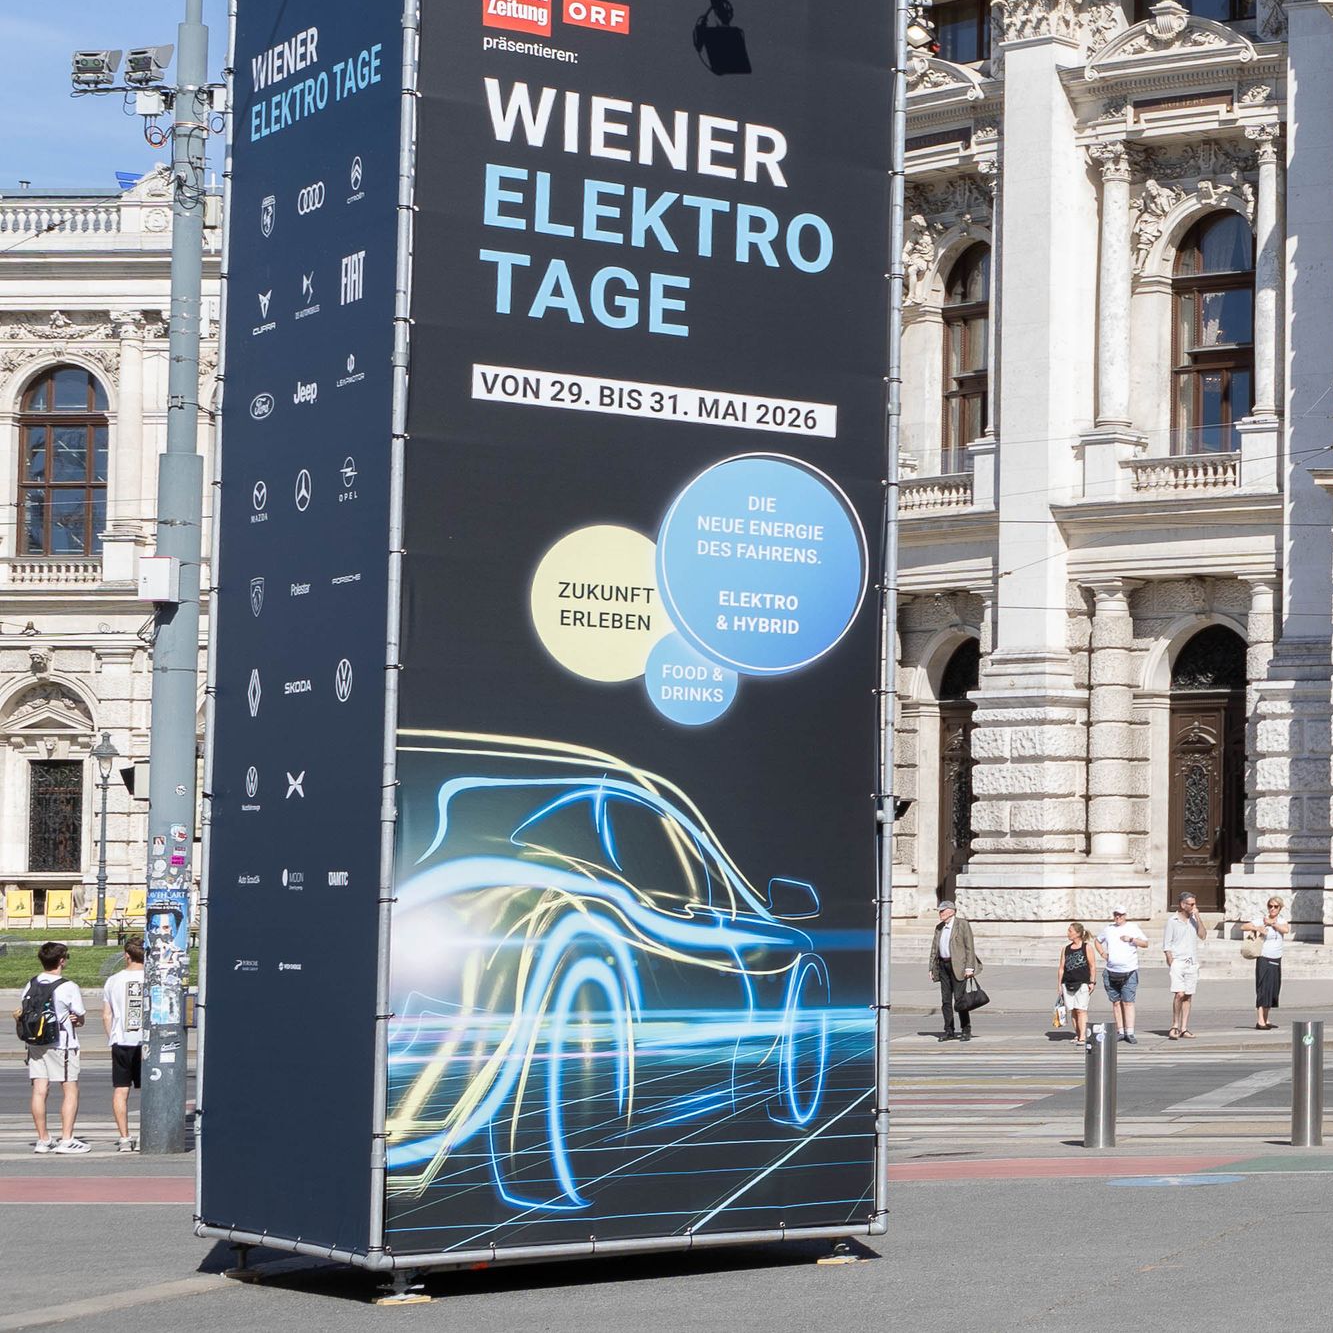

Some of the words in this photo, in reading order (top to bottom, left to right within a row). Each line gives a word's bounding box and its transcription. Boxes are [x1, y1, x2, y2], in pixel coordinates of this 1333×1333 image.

[568, 2, 625, 27] ORF
[252, 26, 319, 93] WIENER
[483, 37, 578, 64] präsentieren:
[251, 71, 329, 142] ELEKTRO
[333, 43, 382, 101] TAGE
[483, 77, 788, 188] WIENER
[483, 163, 834, 274] ELEKTRO
[340, 250, 366, 306] FIAT
[479, 248, 690, 337] TAGE
[252, 322, 277, 336] CUPRA
[293, 381, 318, 405] Jeep
[480, 371, 541, 399] VON
[549, 379, 591, 406] 29.
[599, 385, 642, 410] BIS
[649, 391, 689, 417] 31.
[697, 396, 747, 423] MAI
[755, 403, 817, 430] 2026
[254, 397, 270, 416] Ford
[338, 491, 359, 503] OPEL
[748, 496, 776, 513] DIE
[251, 512, 269, 524] MAZDA
[697, 516, 744, 535] NEUE
[749, 521, 824, 542] ENERGIE
[697, 540, 730, 557] DES
[736, 543, 822, 565] FAHRENS.
[290, 582, 312, 597] Polestar
[331, 573, 361, 585] PORSCHE
[558, 581, 655, 605] ZUKUNFT
[718, 591, 798, 611] ELEKTRO
[560, 610, 652, 632] ERLEBEN
[716, 615, 728, 632] &
[733, 616, 800, 635] HYBRID
[661, 664, 708, 681] FOOD
[712, 667, 723, 682] &
[661, 685, 724, 703] DRINKS
